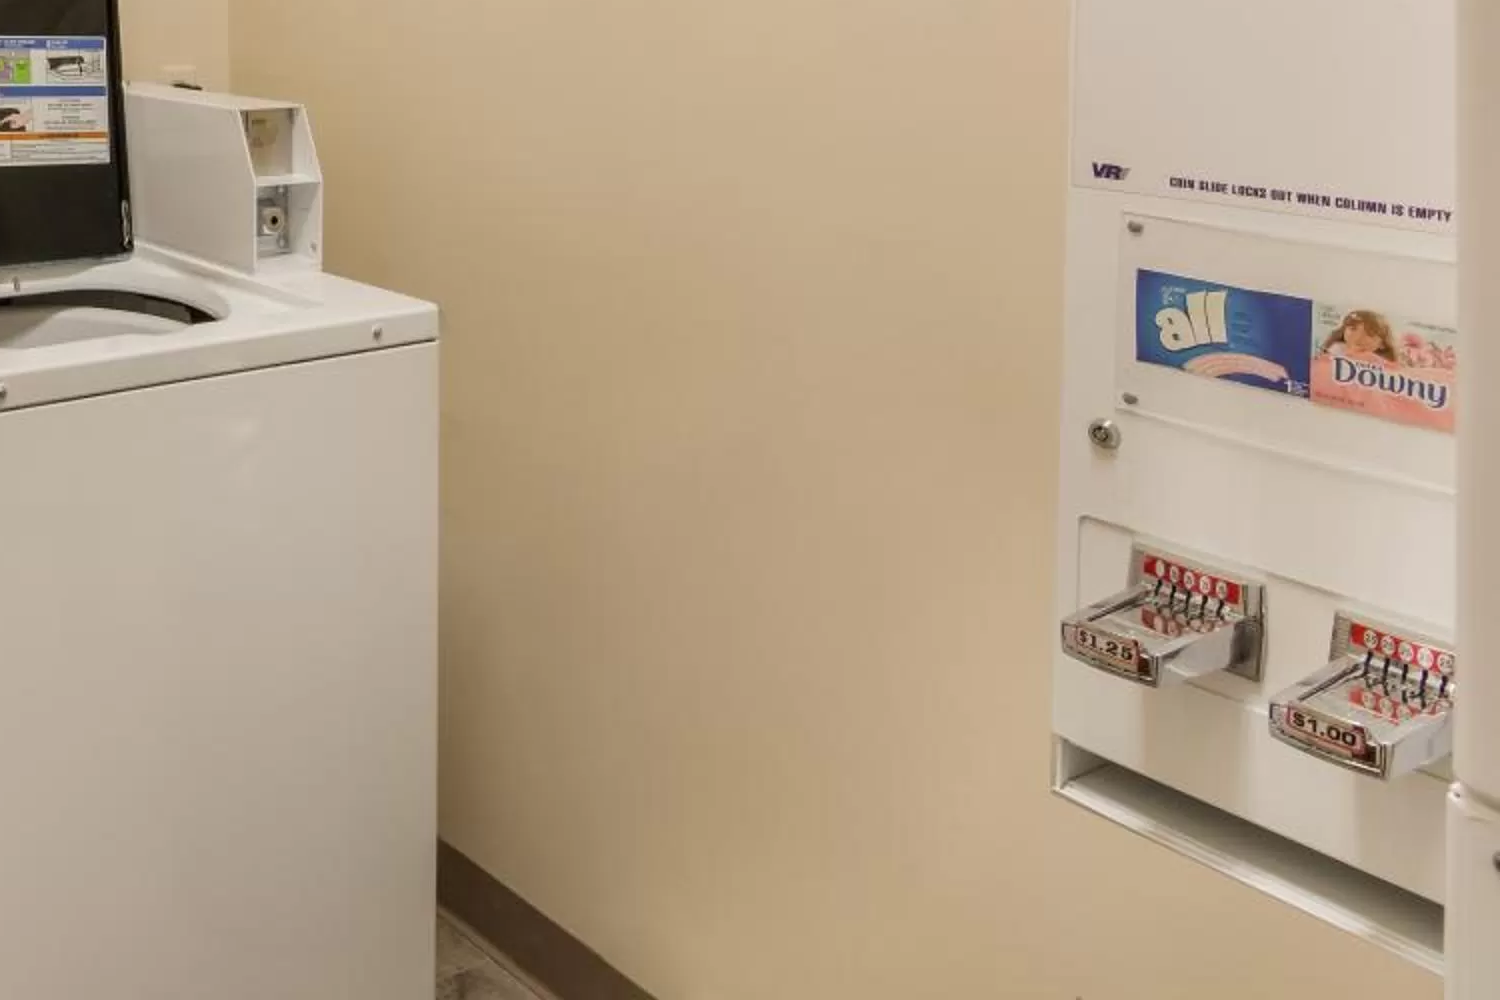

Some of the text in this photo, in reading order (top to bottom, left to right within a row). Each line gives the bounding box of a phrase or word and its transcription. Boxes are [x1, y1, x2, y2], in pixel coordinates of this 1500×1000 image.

[1169, 176, 1452, 223] COIN SLIDE LOCKS OUT WHEN COLUMN IS EMPTY
[1155, 288, 1229, 352] all
[1334, 356, 1448, 409] Downy
[1079, 629, 1134, 661] $1.25
[1292, 711, 1357, 746] $1.00
